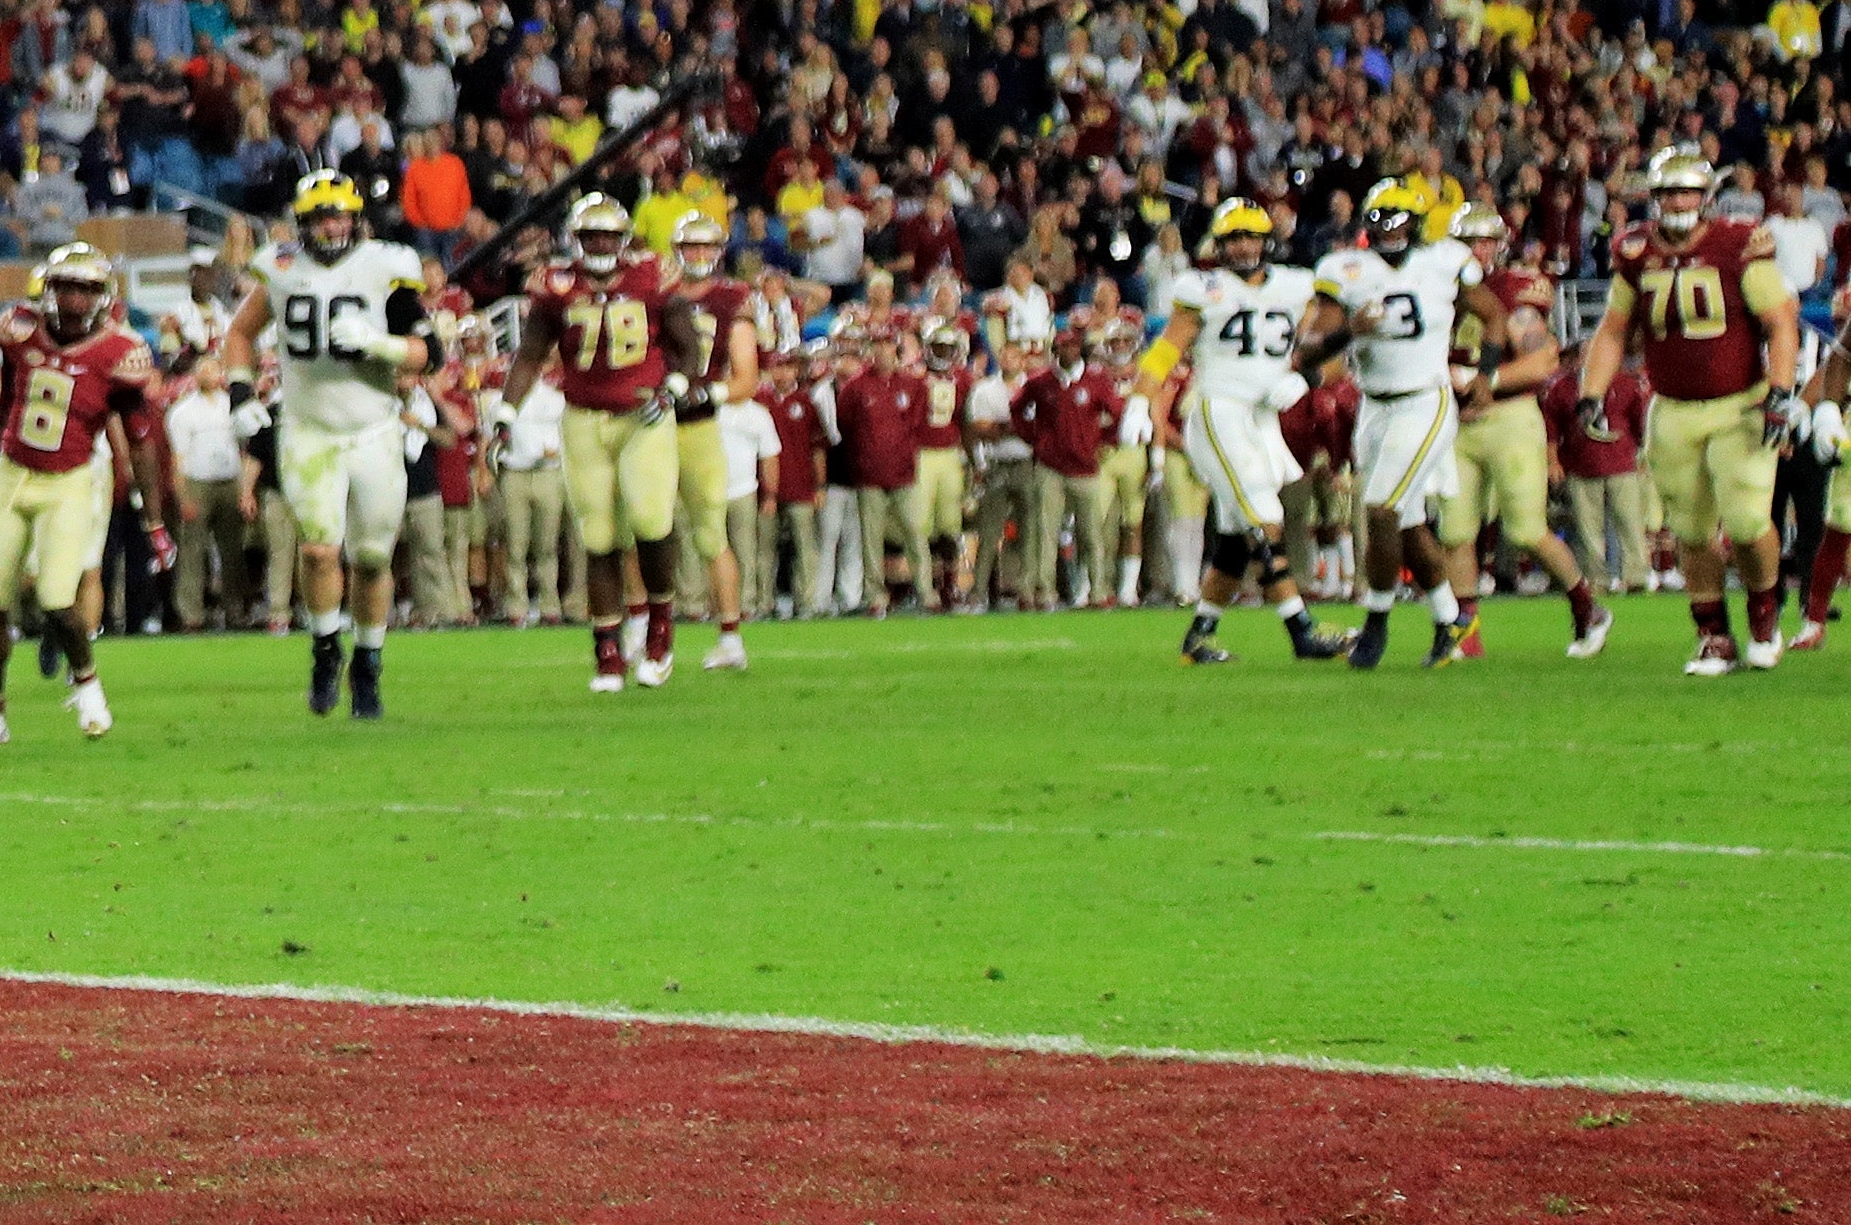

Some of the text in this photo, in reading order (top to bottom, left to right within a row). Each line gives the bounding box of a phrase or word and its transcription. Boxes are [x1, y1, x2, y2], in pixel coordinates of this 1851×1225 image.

[564, 300, 649, 372] 78
[1219, 310, 1295, 358] 43
[1639, 266, 1728, 342] 70
[20, 367, 77, 452] 8
